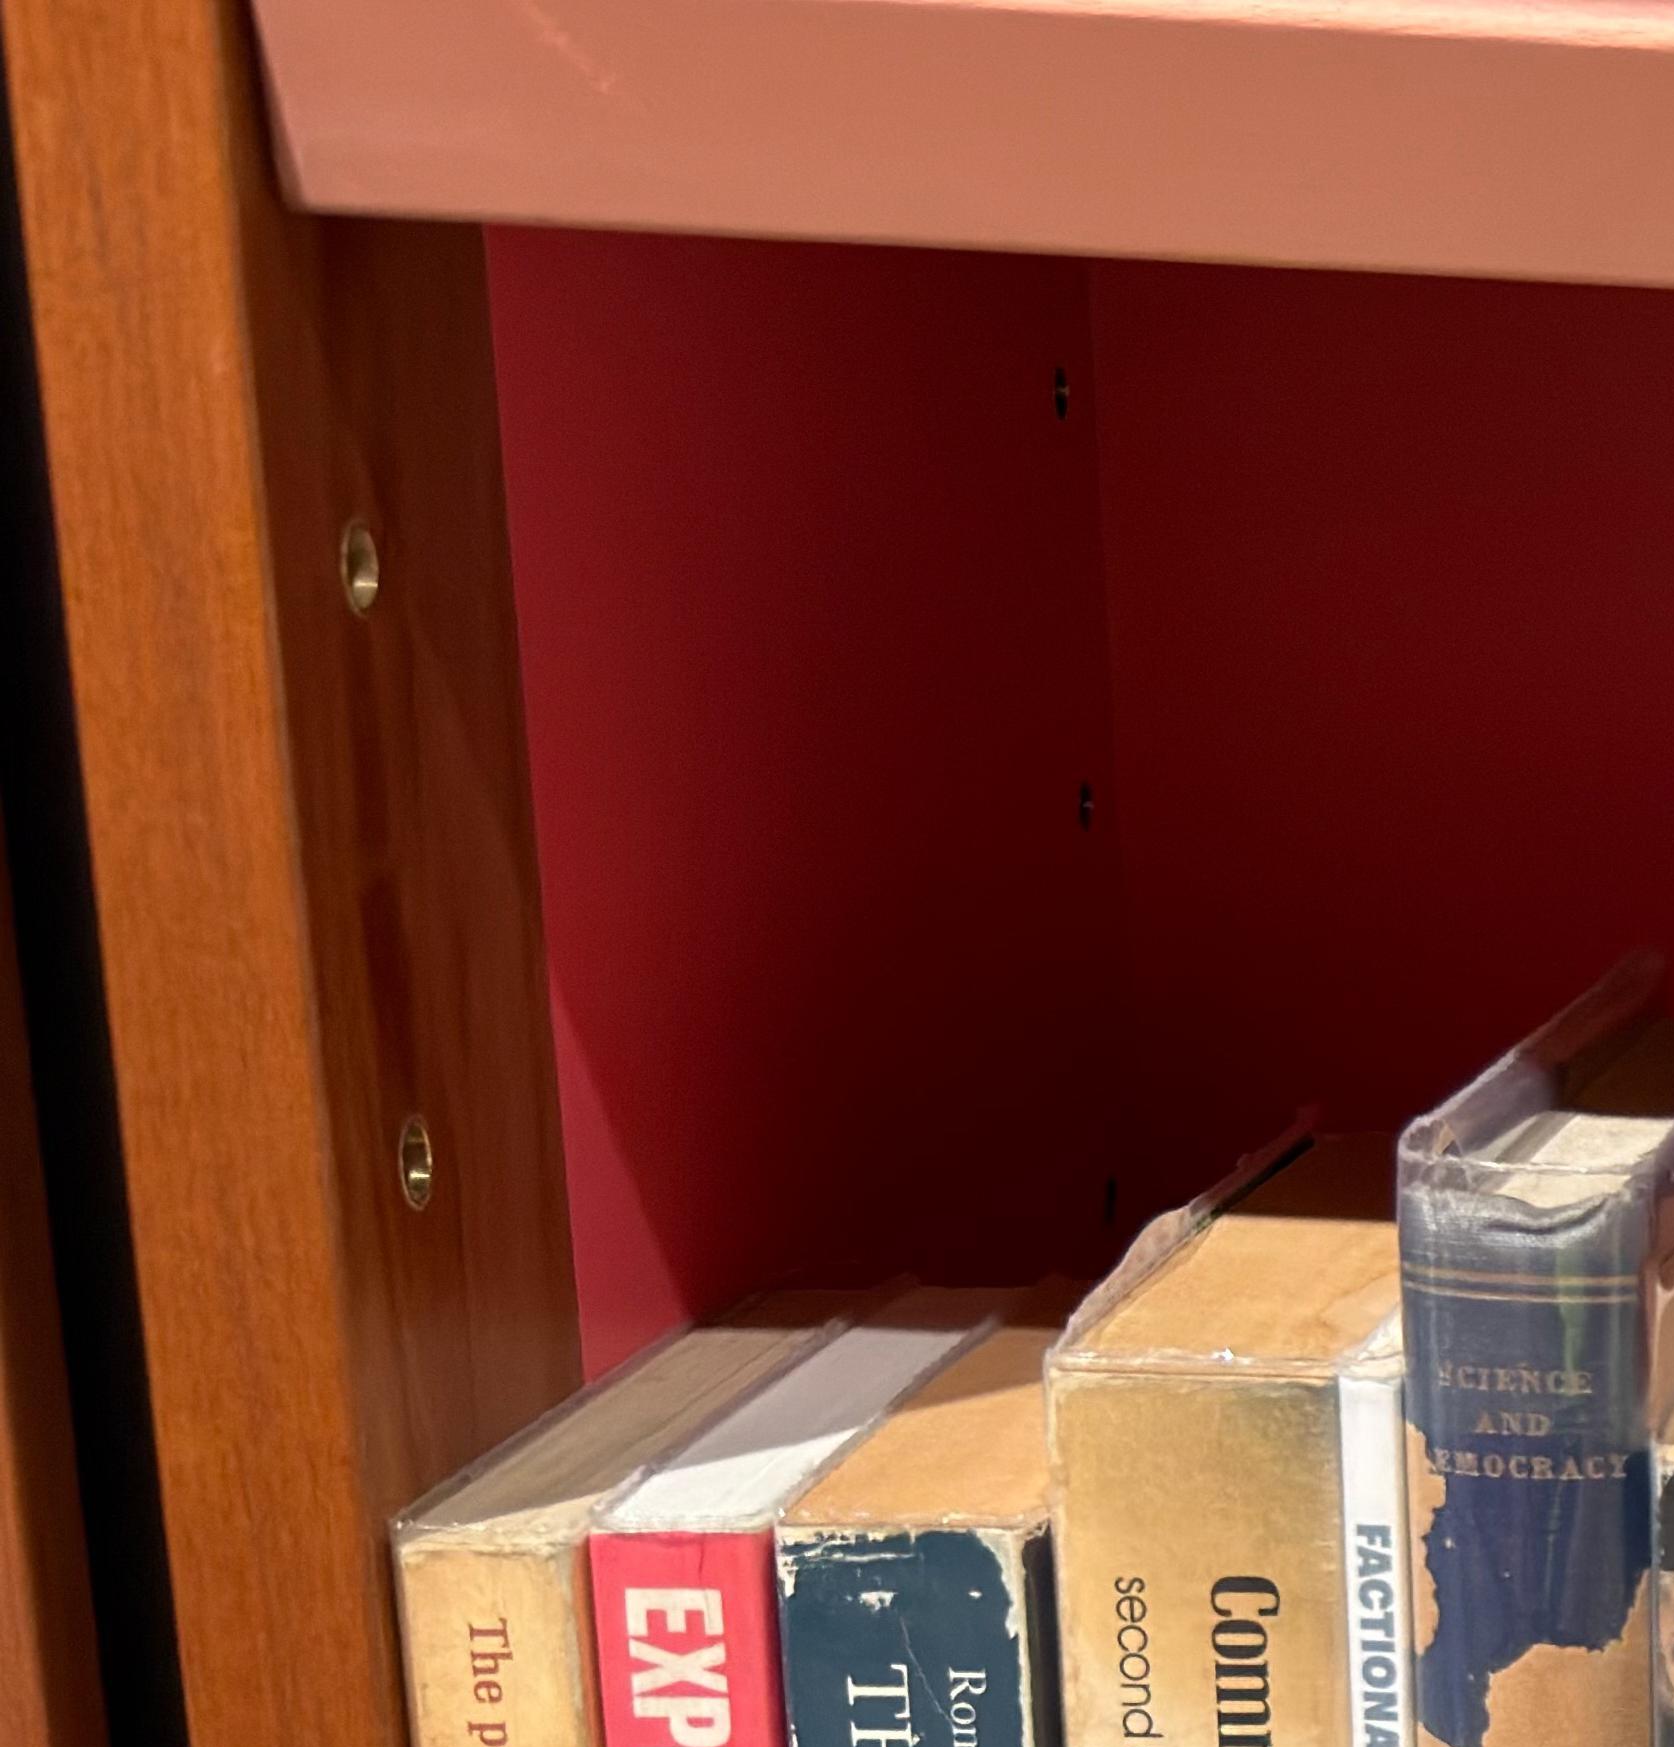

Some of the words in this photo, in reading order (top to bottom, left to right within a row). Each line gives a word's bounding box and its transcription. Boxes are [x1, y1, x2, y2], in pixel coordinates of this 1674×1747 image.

[1439, 1362, 1593, 1394] SCIENCE
[1474, 1412, 1551, 1437] AND
[1114, 1575, 1163, 1739] second
